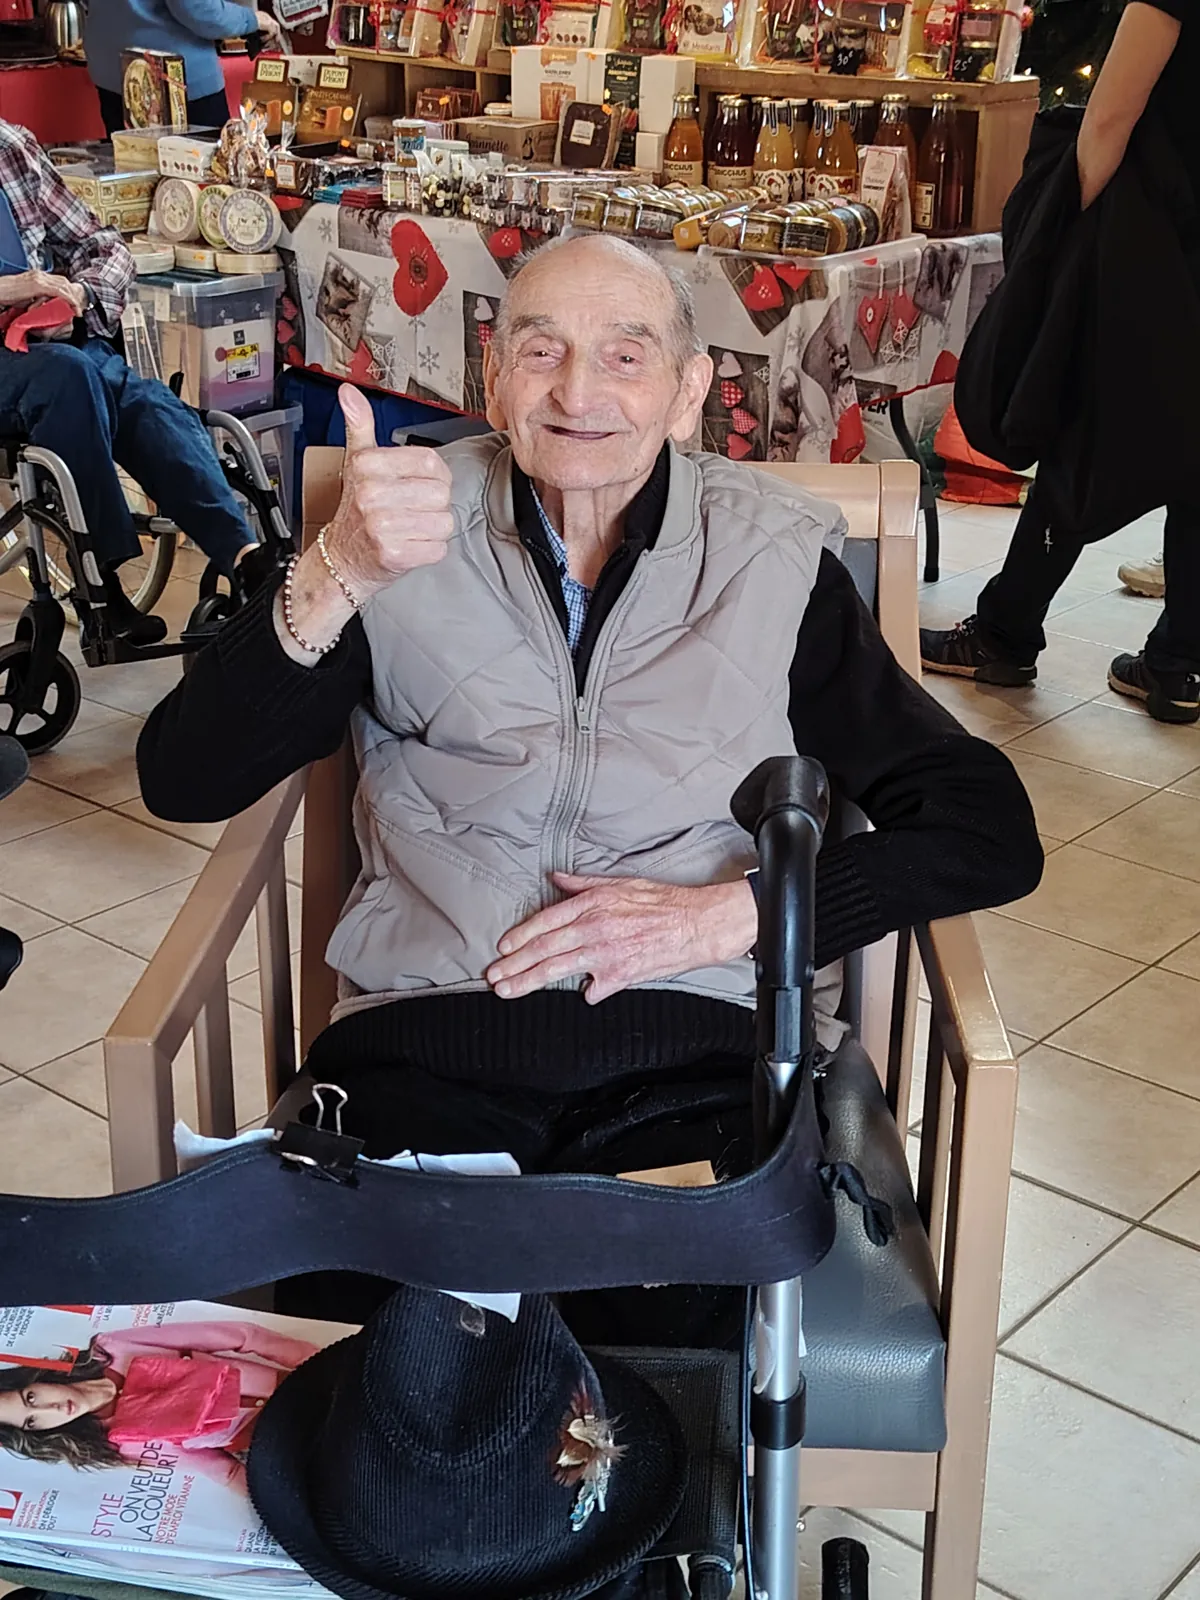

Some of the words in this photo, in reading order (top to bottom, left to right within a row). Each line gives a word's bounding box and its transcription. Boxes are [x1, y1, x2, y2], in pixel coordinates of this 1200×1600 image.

[140, 1441, 163, 1460] DE
[127, 1460, 156, 1494] VEUT
[90, 1493, 124, 1538] STYLE
[119, 1495, 145, 1523] ON
[161, 1494, 178, 1518] MODE
[165, 1511, 183, 1545] D'EMPLOI
[175, 1475, 195, 1512] VITAMINE
[132, 1523, 157, 1542] LA
[153, 1515, 171, 1544] NOTRE
